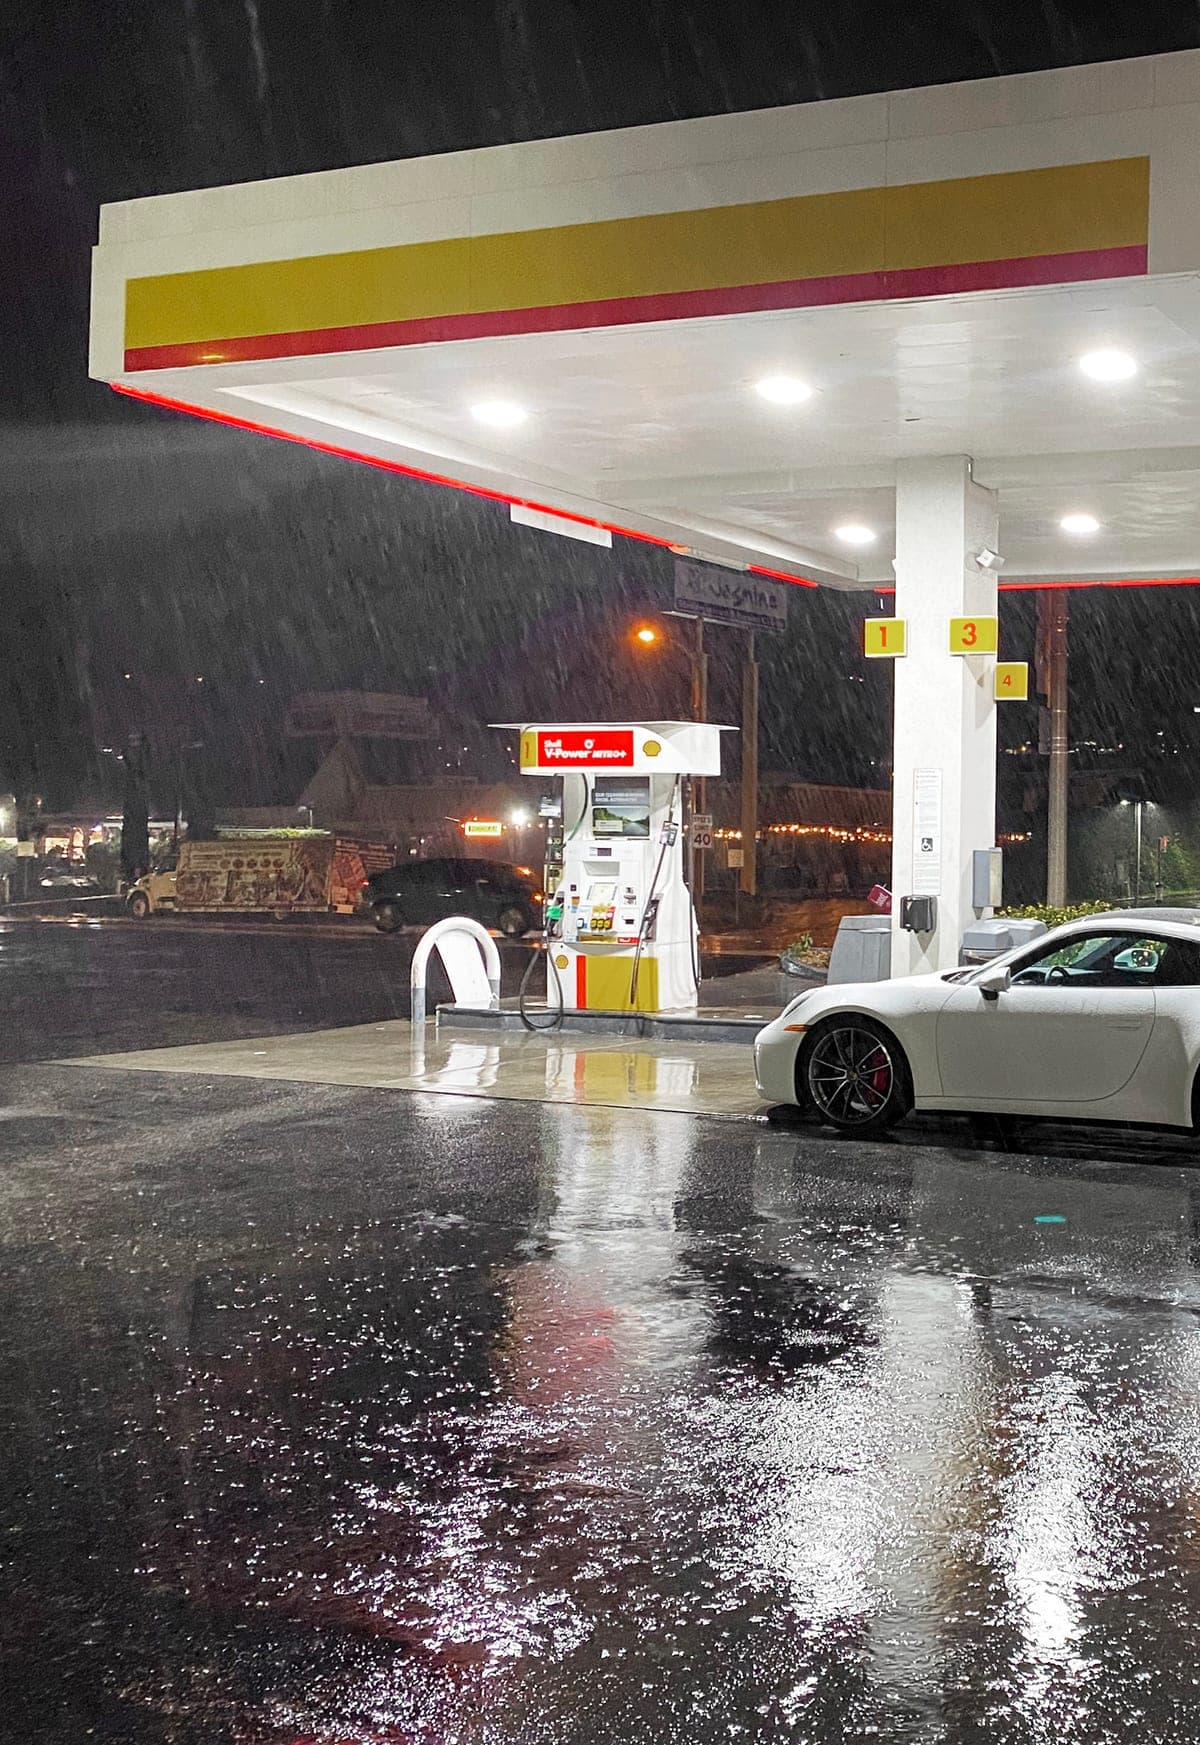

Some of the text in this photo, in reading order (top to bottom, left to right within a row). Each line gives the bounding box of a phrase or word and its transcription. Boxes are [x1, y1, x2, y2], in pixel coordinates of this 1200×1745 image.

[879, 626, 887, 647] 1
[961, 623, 977, 646] 3
[1002, 675, 1012, 687] 4
[524, 741, 529, 759] 1
[544, 739, 562, 748] Shell
[544, 749, 627, 759] V-Power NITRO+
[694, 833, 711, 846] 40
